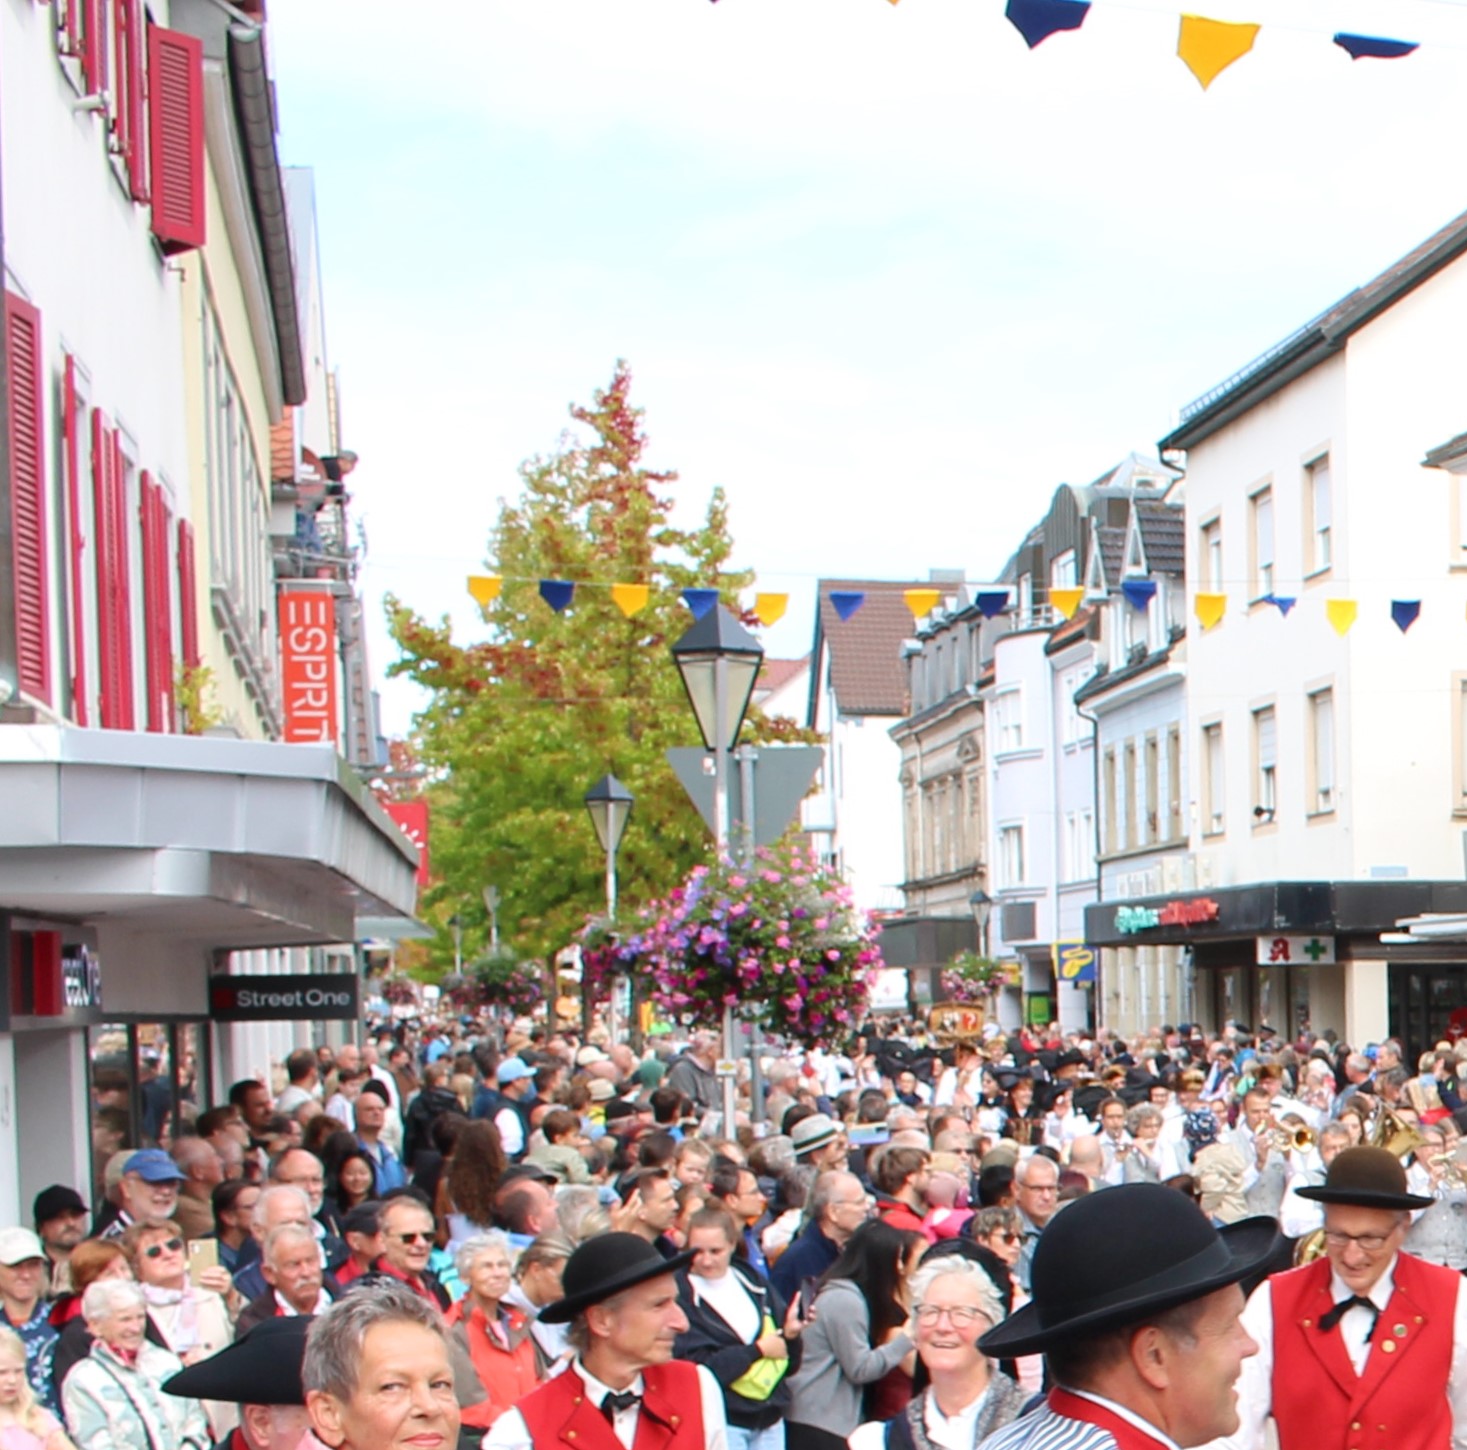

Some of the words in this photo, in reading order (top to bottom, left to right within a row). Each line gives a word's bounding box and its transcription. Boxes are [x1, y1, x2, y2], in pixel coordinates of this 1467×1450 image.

[288, 601, 328, 742] ESPRIT
[236, 989, 303, 1008] Street
[305, 988, 351, 1007] One
